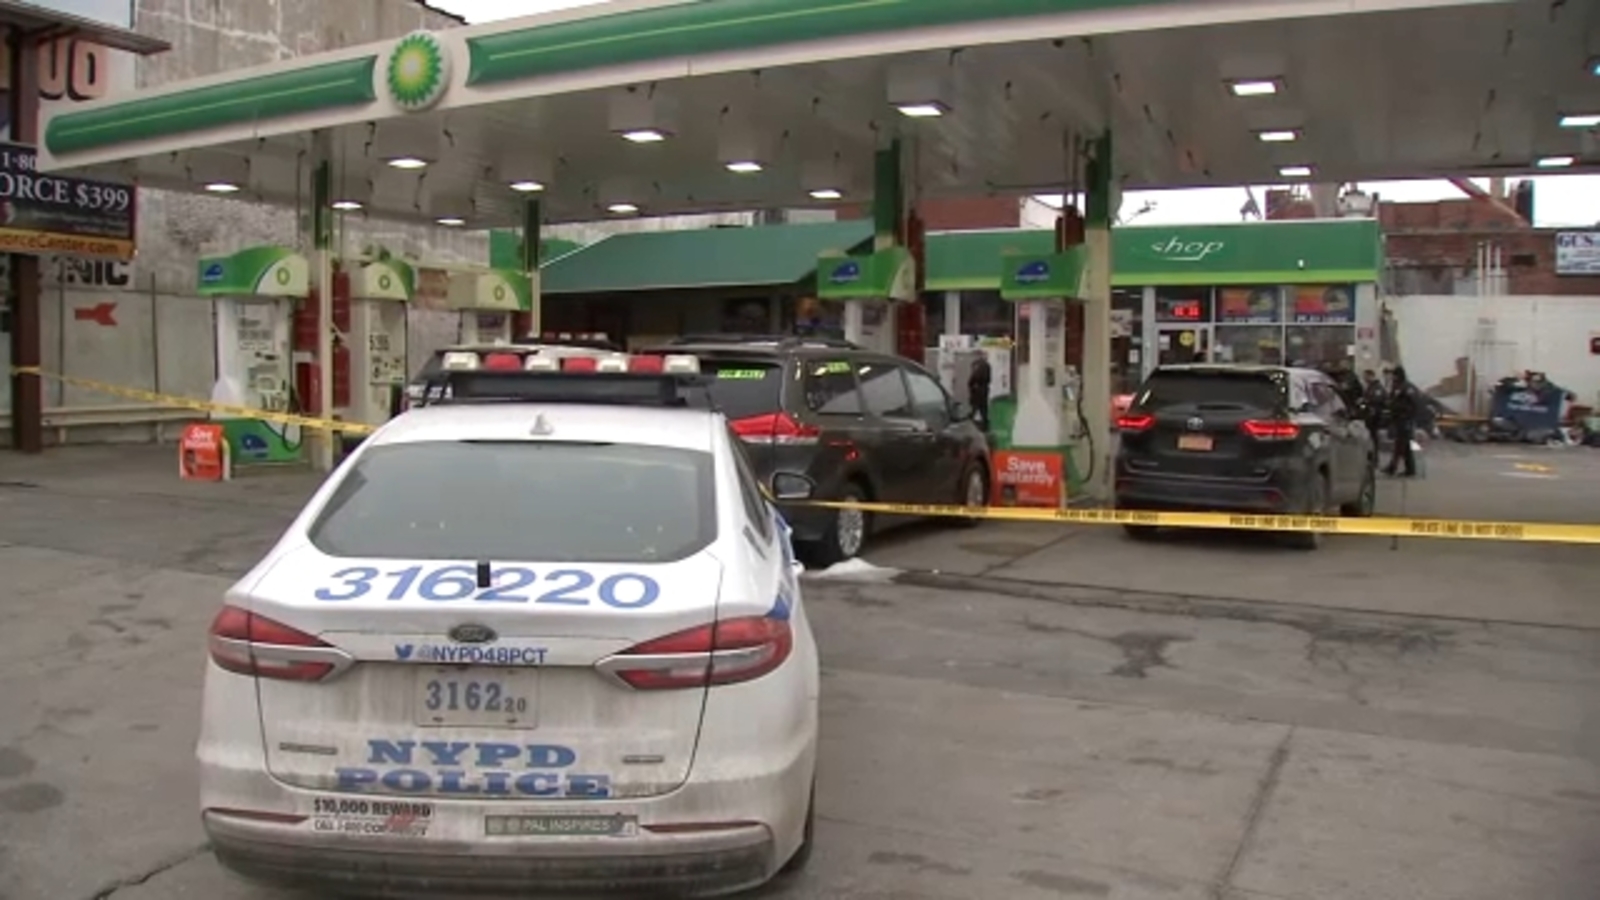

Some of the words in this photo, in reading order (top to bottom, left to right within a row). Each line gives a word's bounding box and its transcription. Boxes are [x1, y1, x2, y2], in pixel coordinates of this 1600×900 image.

[75, 183, 129, 211] $399
[1151, 236, 1224, 261] shop
[1007, 455, 1046, 474] Save
[314, 564, 661, 609] 316220
[425, 680, 501, 711] 3162
[504, 697, 526, 713] 20
[367, 740, 576, 769] NYPD
[336, 767, 609, 798] POLICE
[314, 799, 368, 815] $10,000
[372, 801, 431, 817] REWARD
[525, 820, 547, 831] PAL
